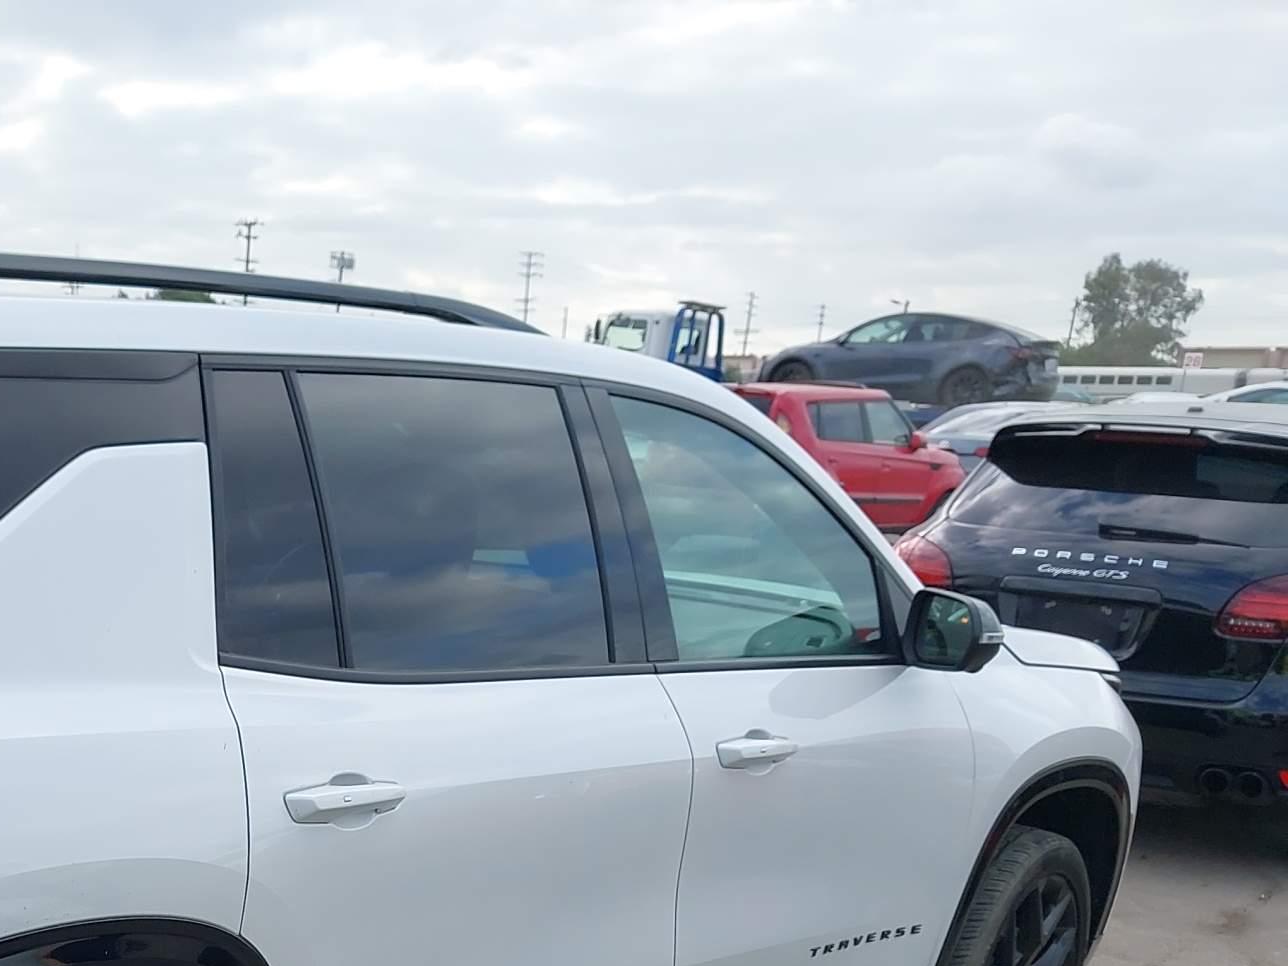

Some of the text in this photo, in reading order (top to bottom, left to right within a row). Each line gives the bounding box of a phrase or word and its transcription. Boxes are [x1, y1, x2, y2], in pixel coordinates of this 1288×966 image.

[1012, 547, 1169, 569] PORSCHE
[1092, 568, 1130, 580] GTS
[809, 923, 923, 959] TRAVERSE
